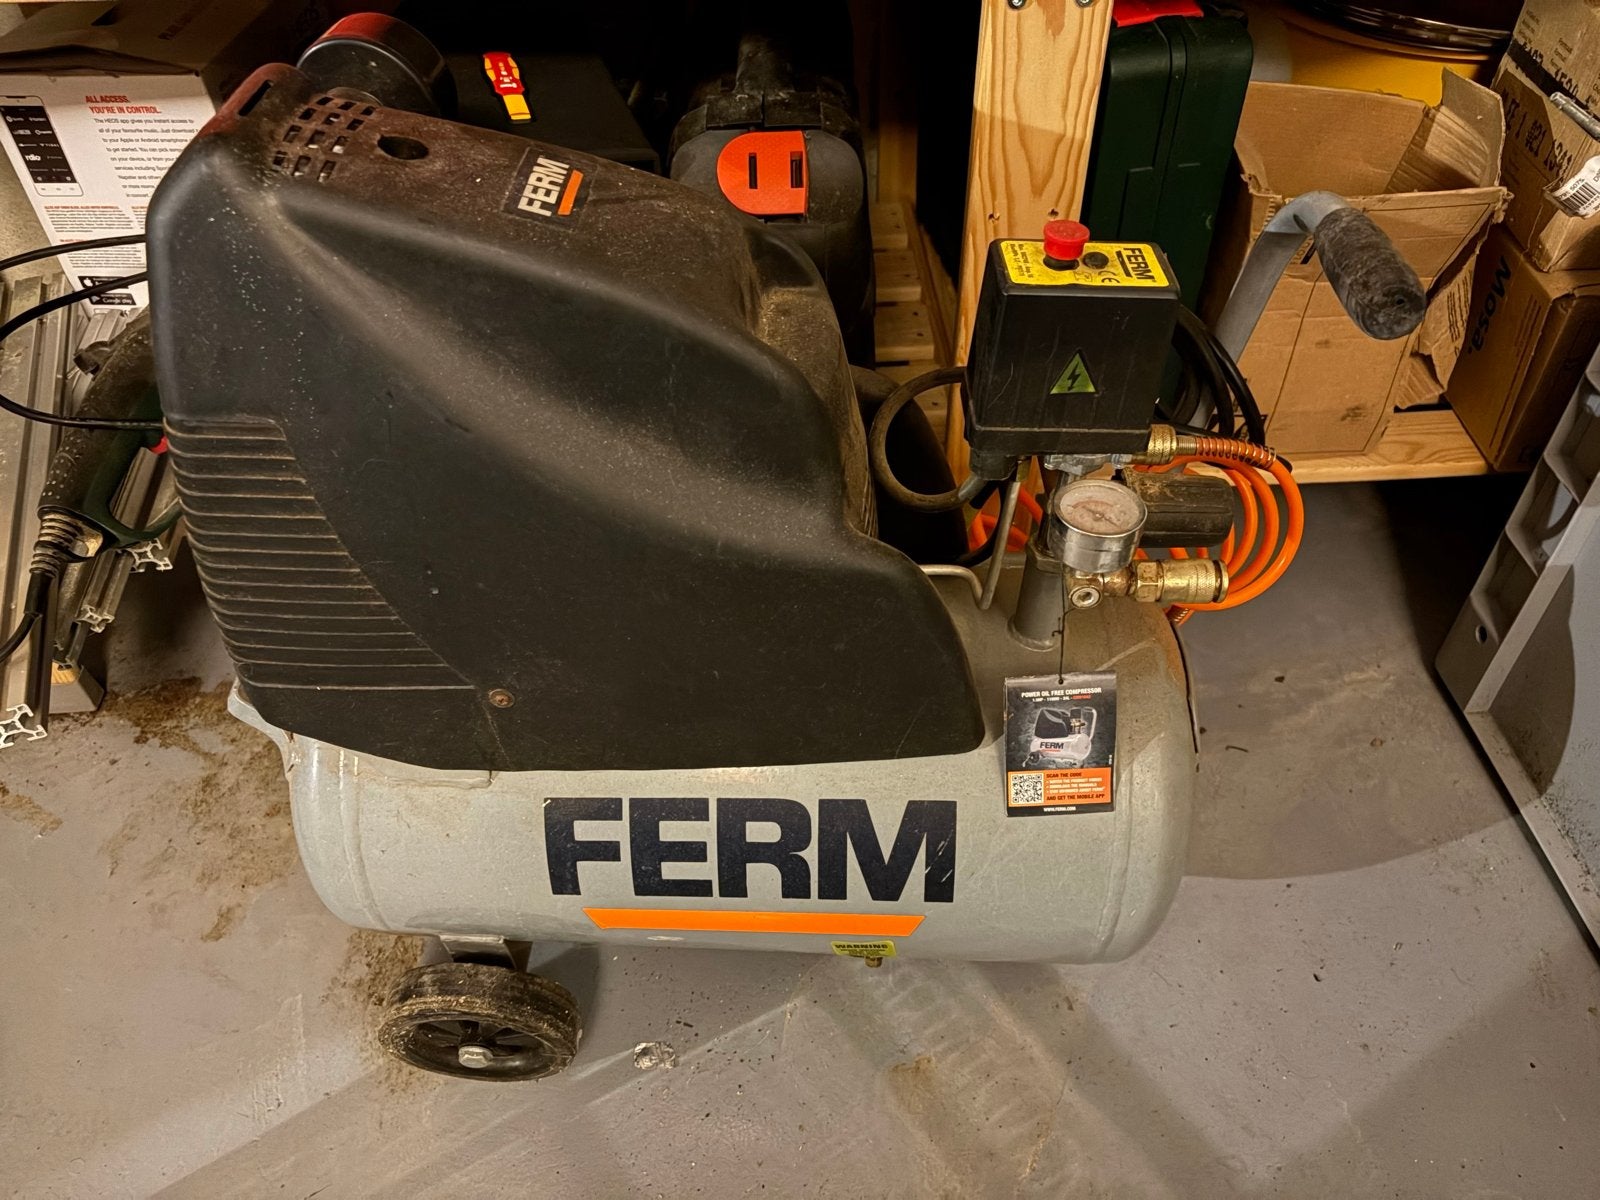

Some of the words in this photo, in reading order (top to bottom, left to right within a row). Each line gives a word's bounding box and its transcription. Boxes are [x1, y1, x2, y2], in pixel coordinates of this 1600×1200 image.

[85, 95, 99, 103] ALL
[89, 106, 117, 114] YOU'RE
[117, 106, 125, 114] IN
[126, 106, 162, 114] CONTROL.
[517, 157, 570, 217] FERM
[1123, 247, 1156, 280] FERM
[1065, 687, 1102, 695] COMPRESSOR
[1039, 741, 1064, 750] FERM
[543, 797, 958, 903] FERM
